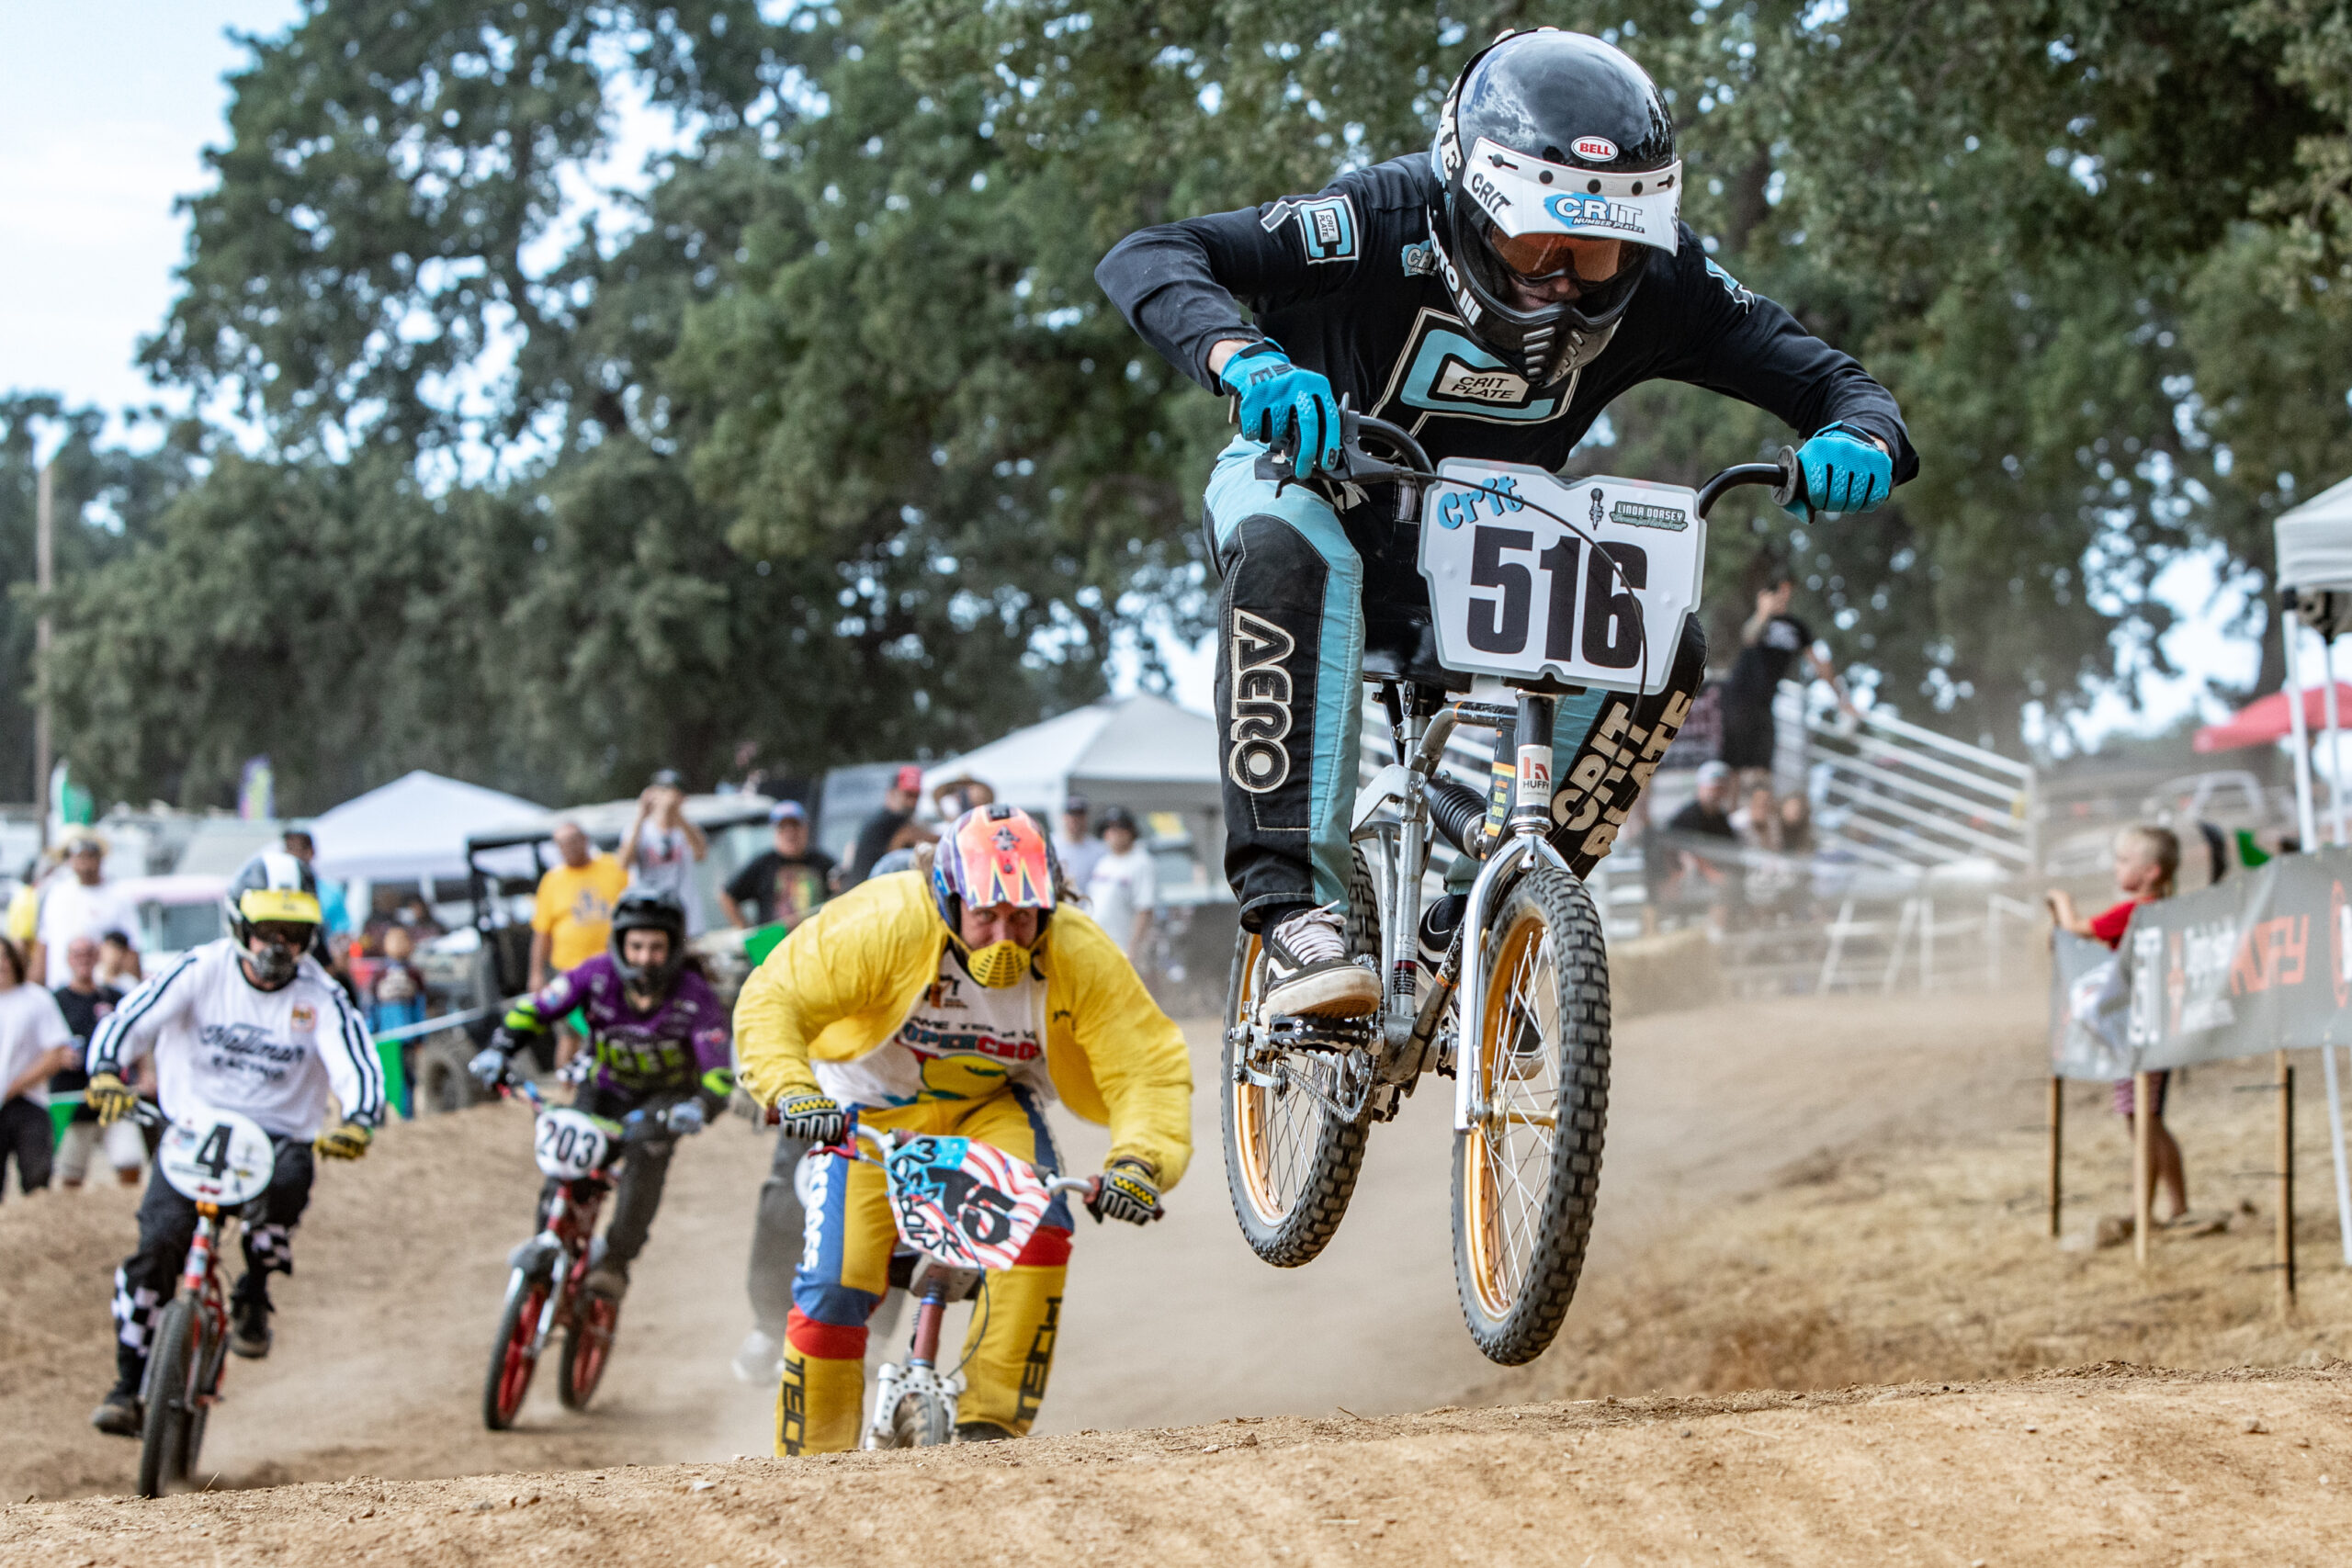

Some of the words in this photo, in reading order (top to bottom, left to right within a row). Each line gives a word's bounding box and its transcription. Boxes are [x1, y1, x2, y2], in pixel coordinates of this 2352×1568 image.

[1579, 142, 1611, 156] BELL
[1472, 173, 1511, 214] CRIT
[1325, 214, 1336, 232] CRIT
[1555, 197, 1643, 226] CRIT
[1317, 214, 1329, 238] PLATE
[1572, 217, 1612, 228] NUMBER
[1612, 221, 1645, 234] PLATES
[1451, 384, 1515, 400] PLATE
[1459, 376, 1510, 389] CRIT
[1618, 503, 1645, 516] LINDA
[1646, 506, 1683, 521] DORSEY
[1466, 524, 1648, 669] 516
[1229, 608, 1295, 794] AERO
[1552, 701, 1649, 831] CRIT
[196, 1124, 232, 1179] 4
[538, 1121, 597, 1168] 203
